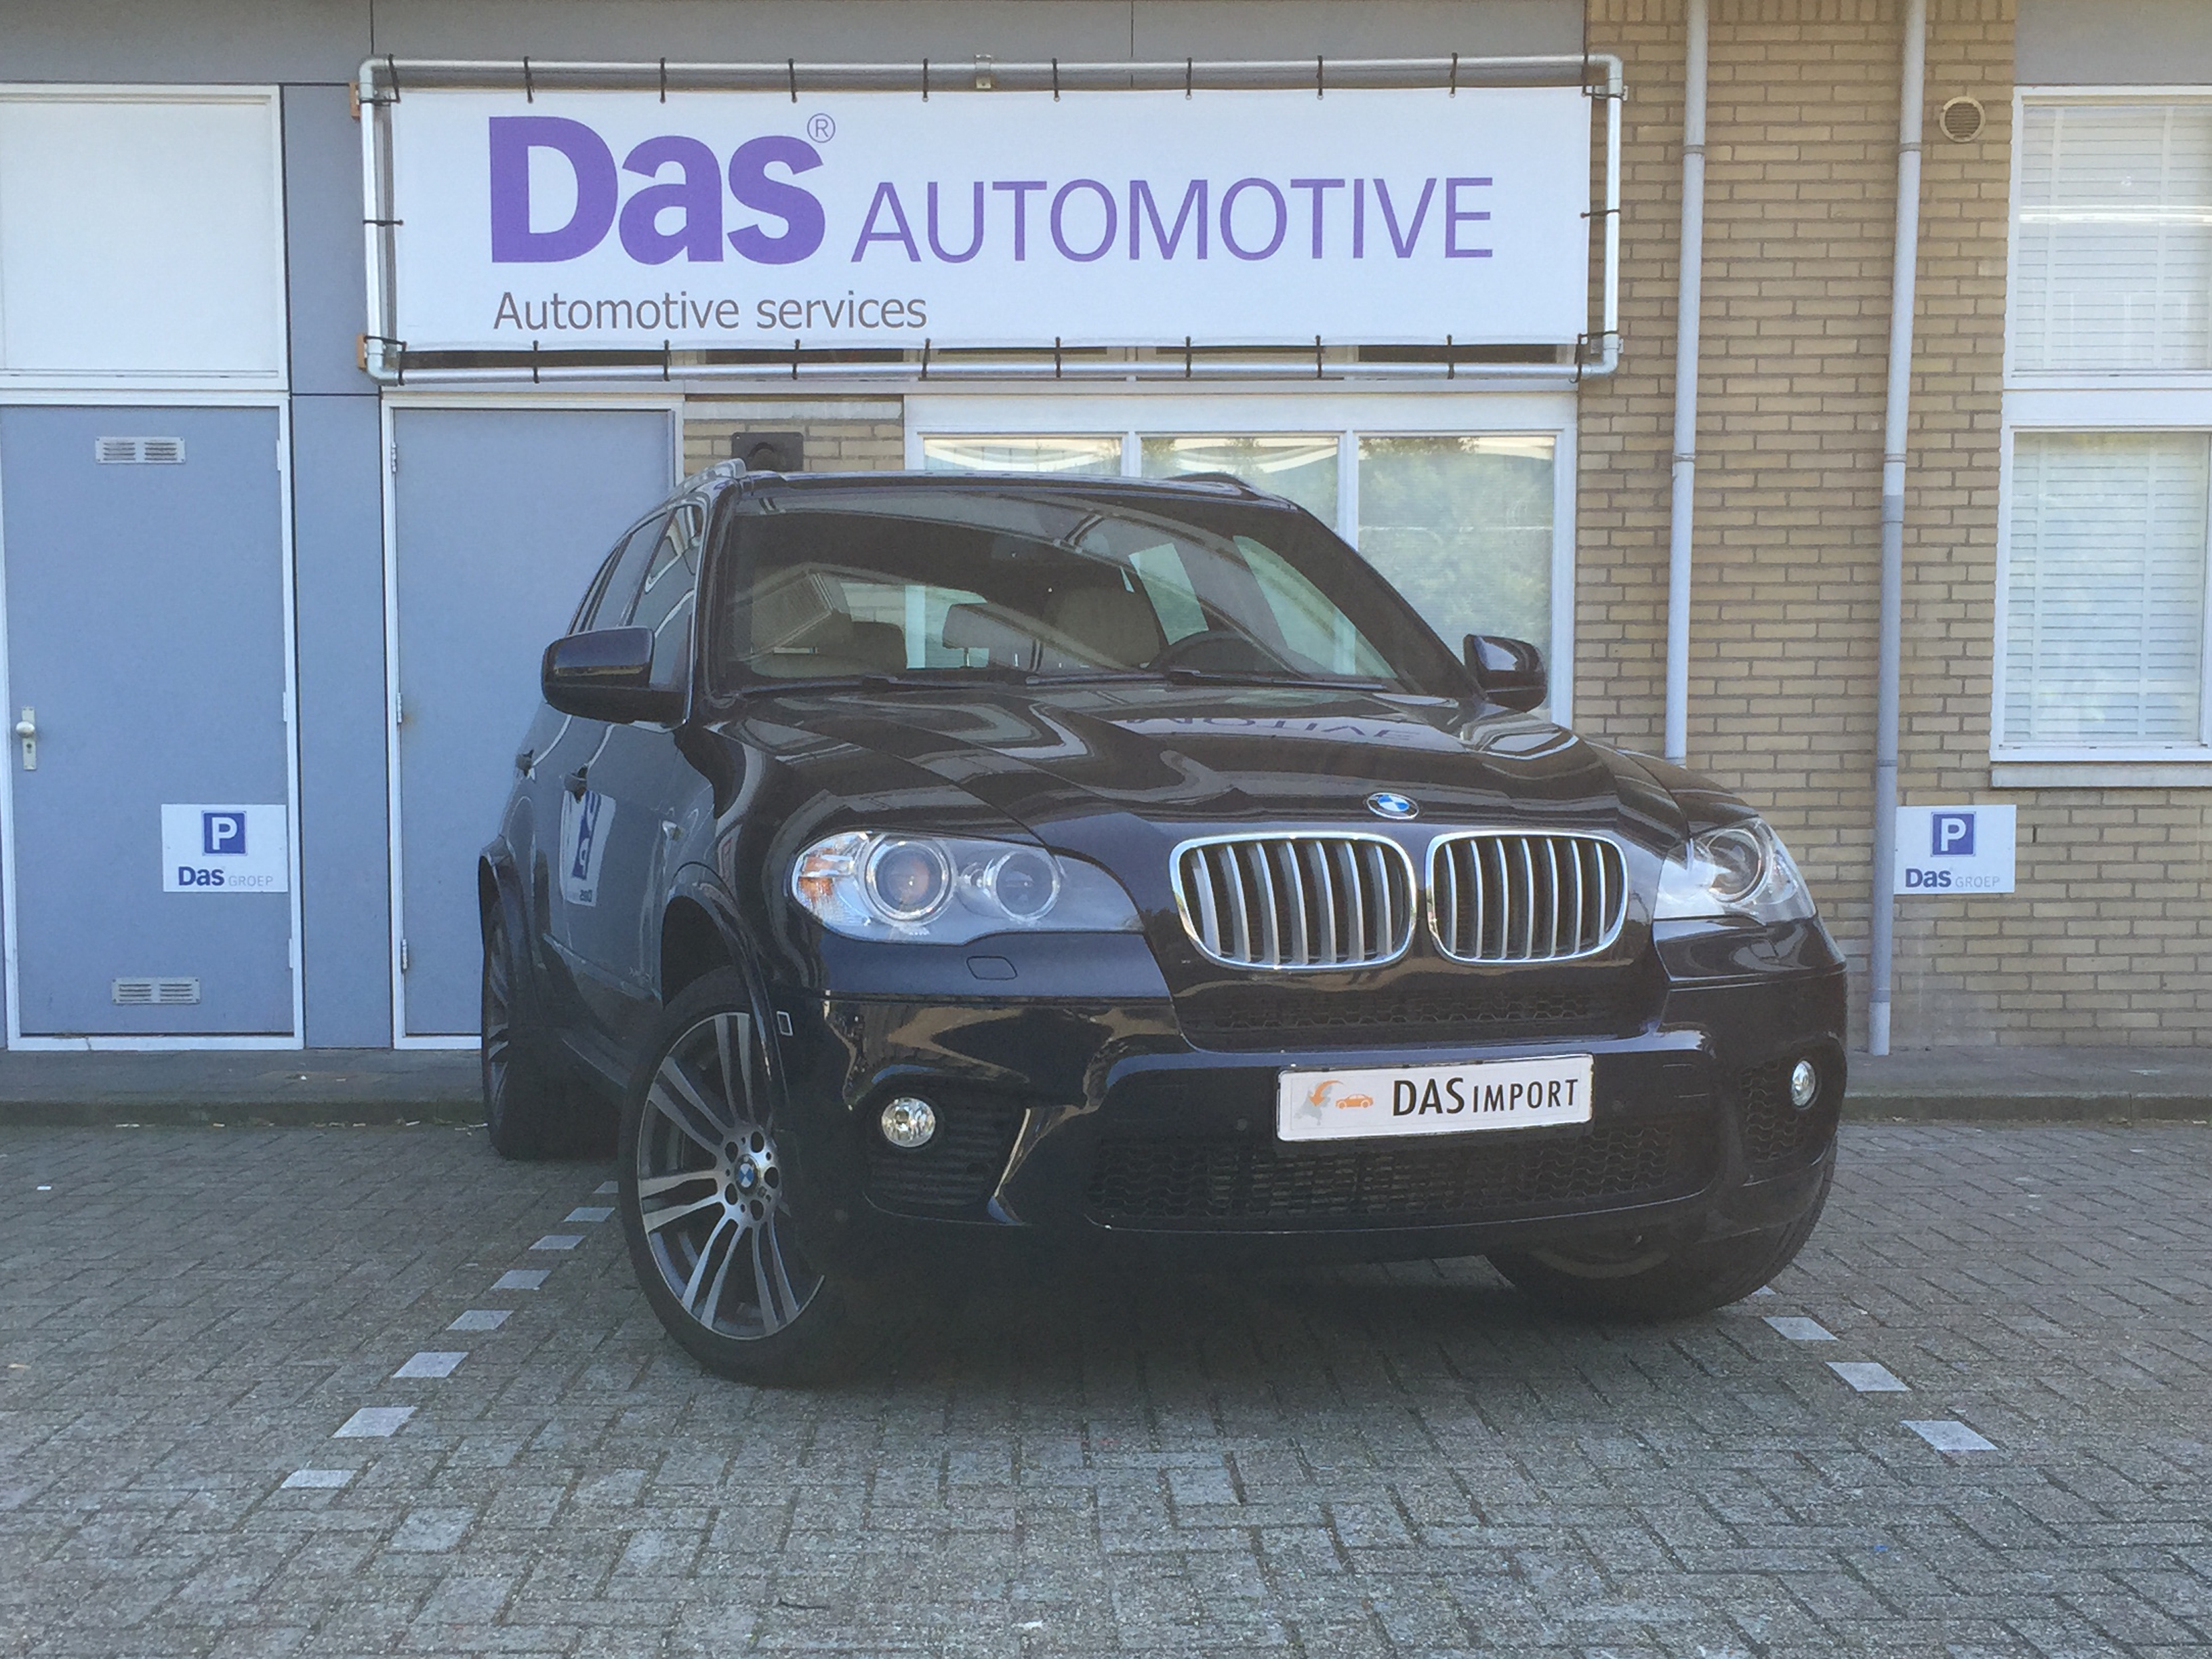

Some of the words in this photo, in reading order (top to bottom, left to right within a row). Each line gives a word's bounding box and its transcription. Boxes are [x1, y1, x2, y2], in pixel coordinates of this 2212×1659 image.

[851, 177, 1493, 263] AUTOMOTIVE
[493, 291, 739, 330] Automotive
[756, 290, 928, 328] services
[211, 817, 238, 851] P
[1941, 818, 1966, 851] P
[178, 866, 225, 886] Das
[228, 875, 273, 886] GROEP
[1905, 868, 1951, 888] Das
[1955, 876, 1999, 888] GROEP
[1393, 1078, 1465, 1115] DAS
[1473, 1079, 1578, 1112] IMPORT
